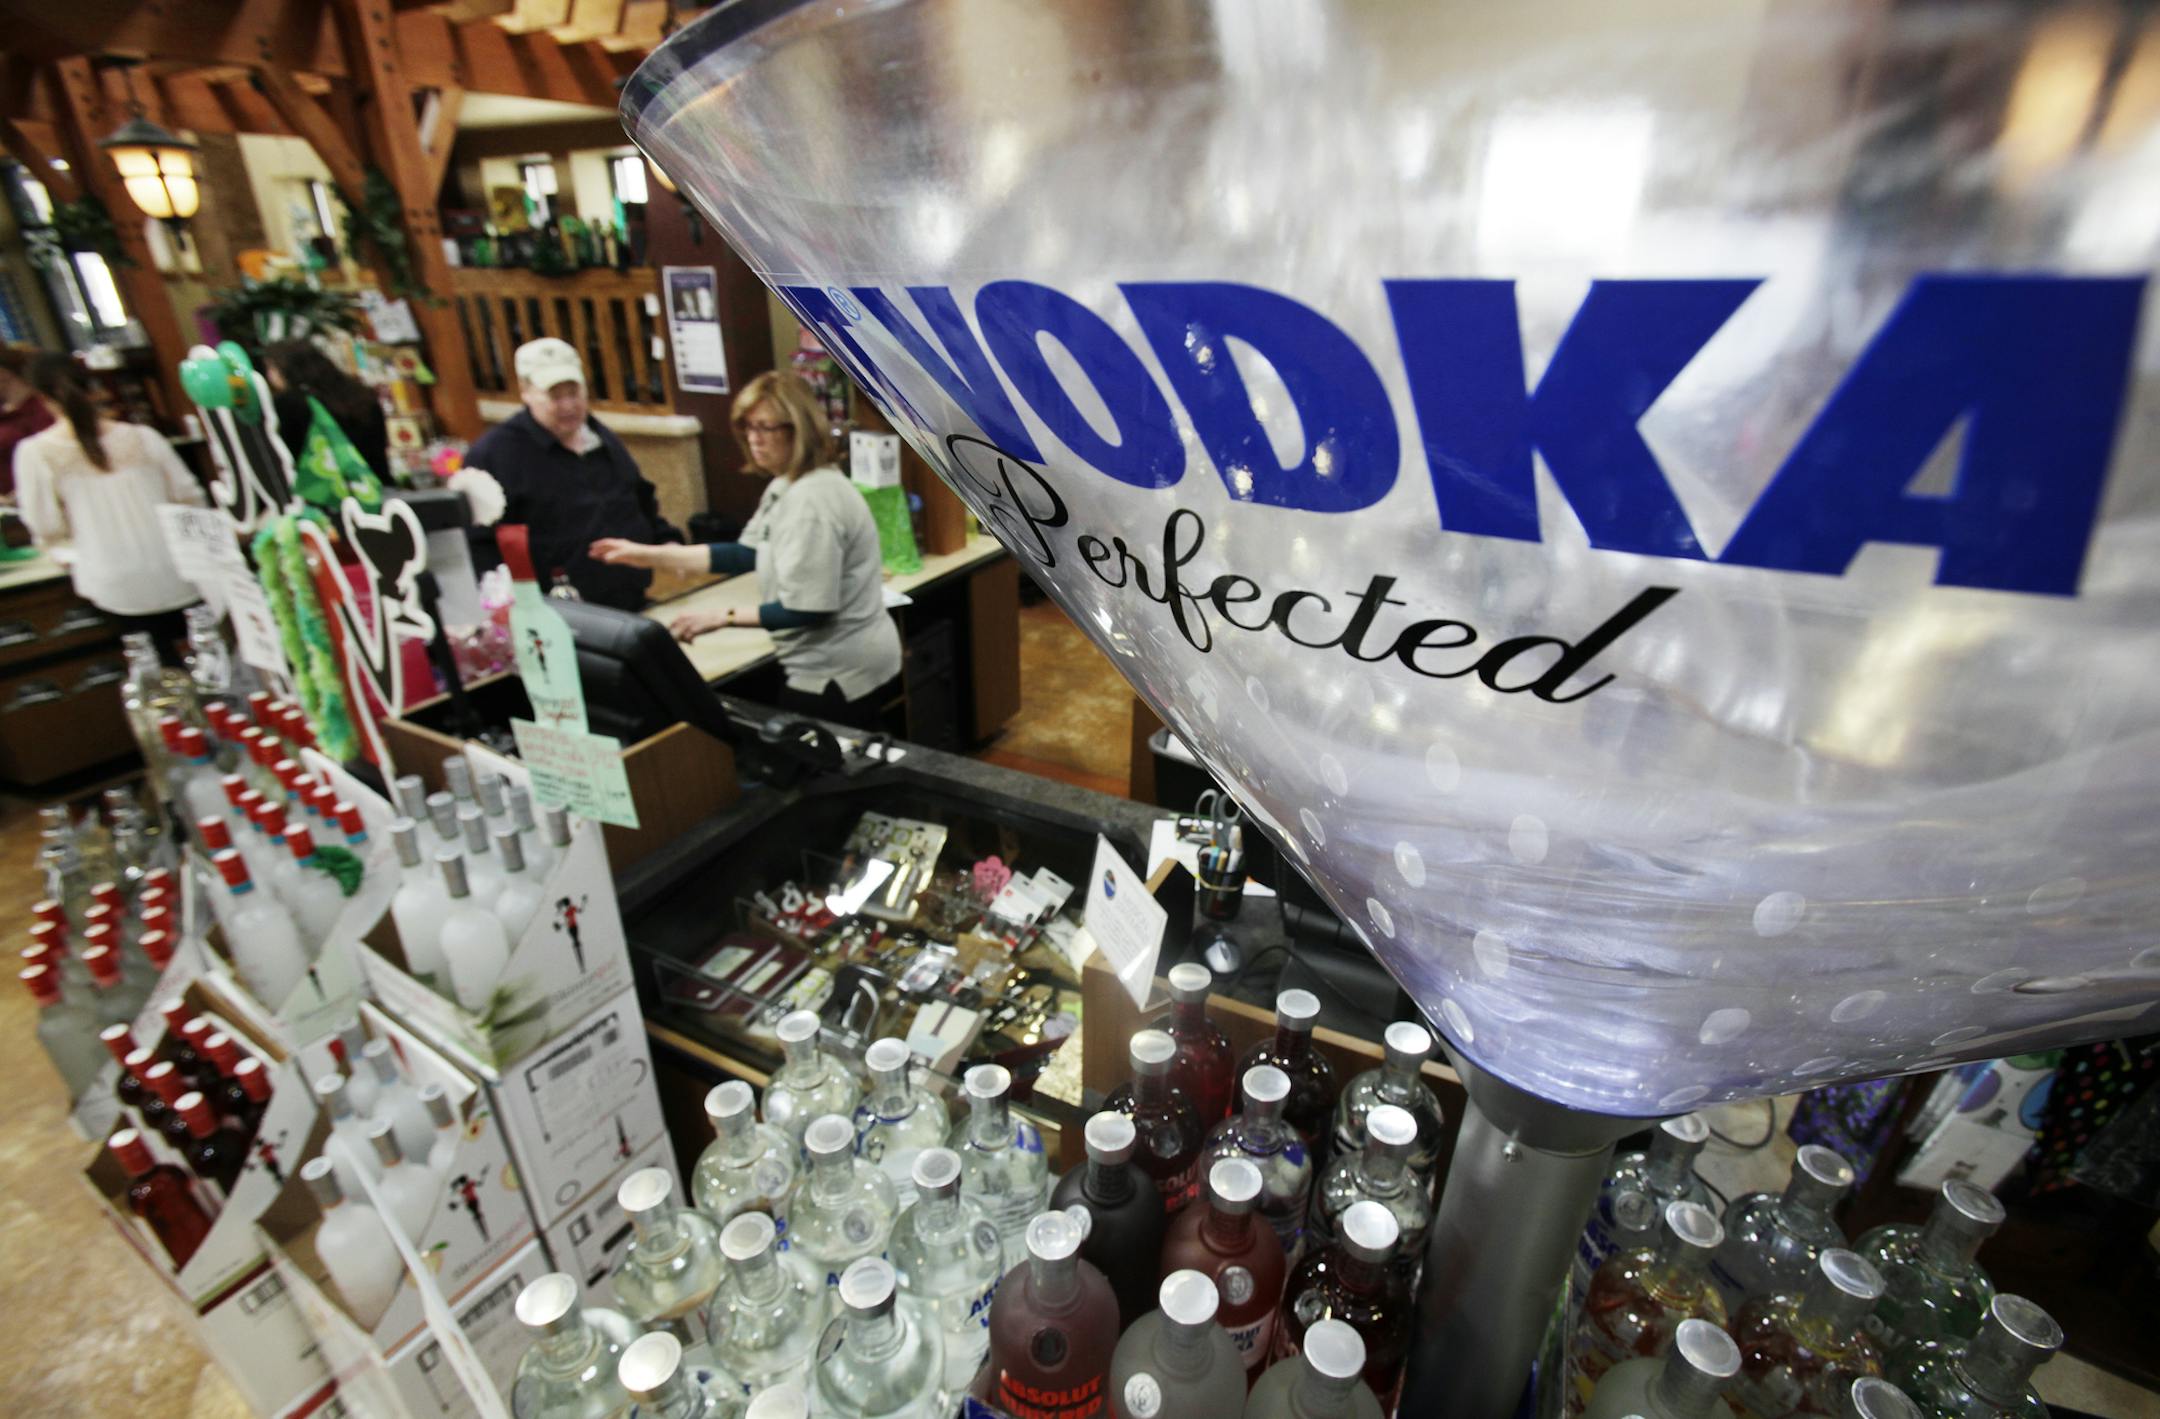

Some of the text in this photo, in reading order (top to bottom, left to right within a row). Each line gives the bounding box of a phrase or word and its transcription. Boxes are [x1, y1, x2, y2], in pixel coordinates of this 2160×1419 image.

[847, 274, 2148, 598] VODKA
[946, 433, 1681, 705] Perfected
[1000, 1372, 1103, 1407] ABSOLUT
